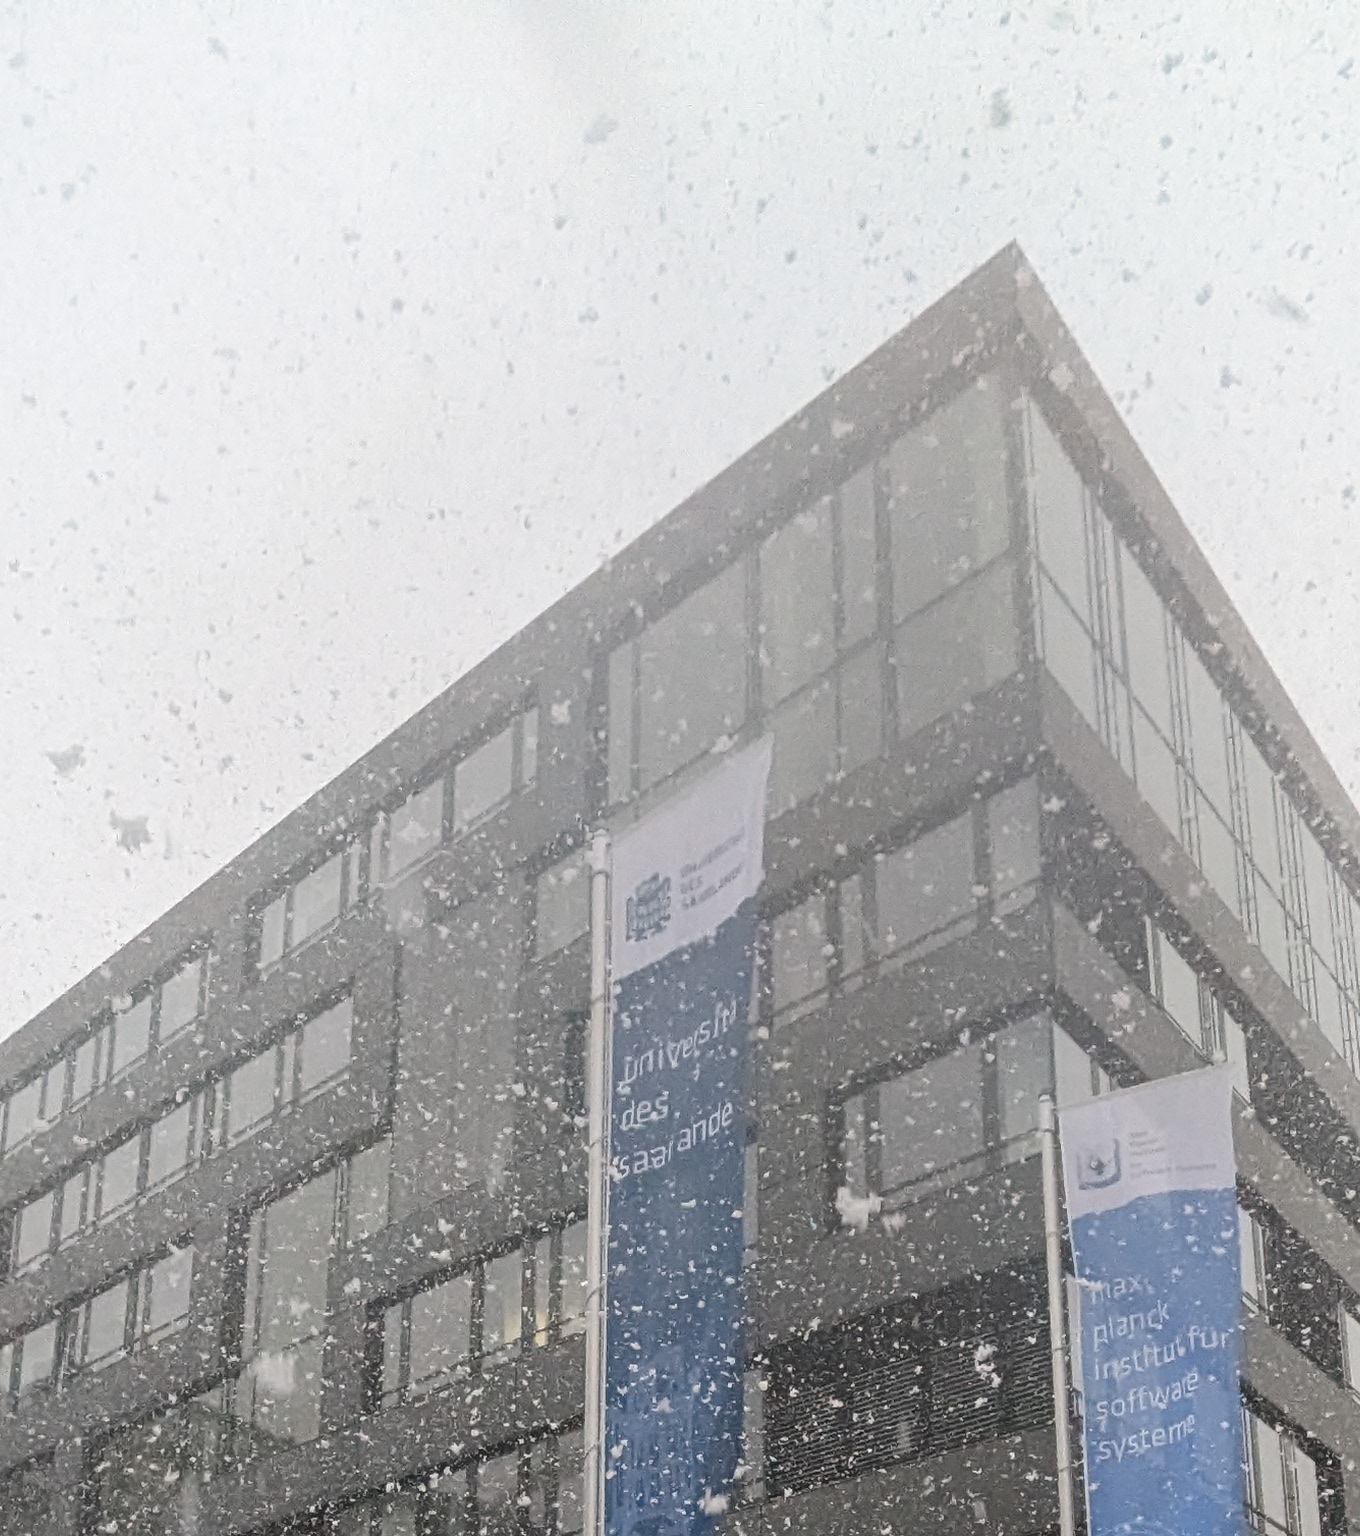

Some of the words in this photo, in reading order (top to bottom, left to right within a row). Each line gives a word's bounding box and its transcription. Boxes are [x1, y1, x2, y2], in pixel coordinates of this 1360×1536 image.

[621, 1091, 669, 1131] des
[1093, 1299, 1169, 1352] planck
[1095, 1335, 1183, 1380] institut
[1187, 1325, 1228, 1350] für
[1096, 1371, 1198, 1420] software
[1096, 1414, 1195, 1462] systeme
